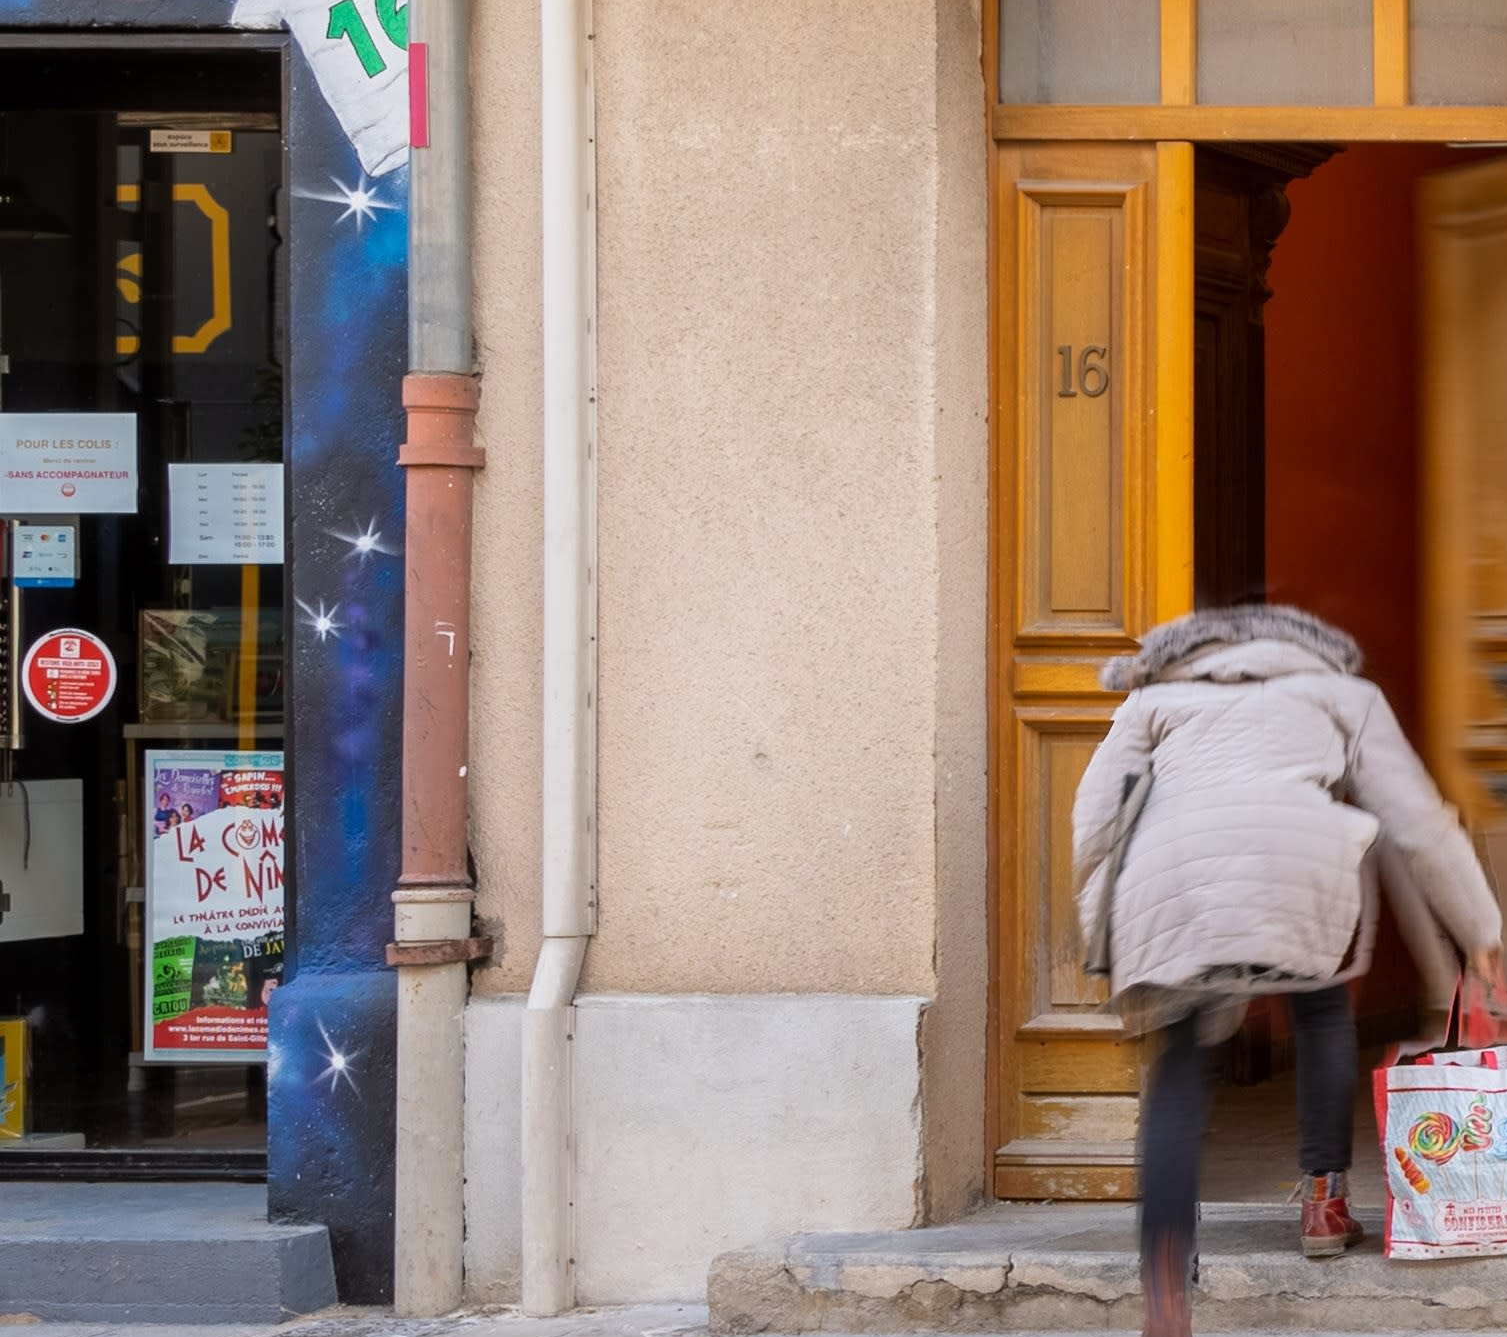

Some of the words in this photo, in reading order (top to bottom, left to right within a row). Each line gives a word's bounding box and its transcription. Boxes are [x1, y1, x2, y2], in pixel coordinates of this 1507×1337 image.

[1057, 344, 1110, 398] 16
[16, 439, 49, 449] POUR
[52, 439, 75, 449] LES
[77, 439, 112, 449] COLIS
[36, 470, 129, 479] ACCOMPAGNATEUR
[176, 824, 206, 862] LA
[195, 866, 227, 902] DE
[216, 924, 231, 934] LA
